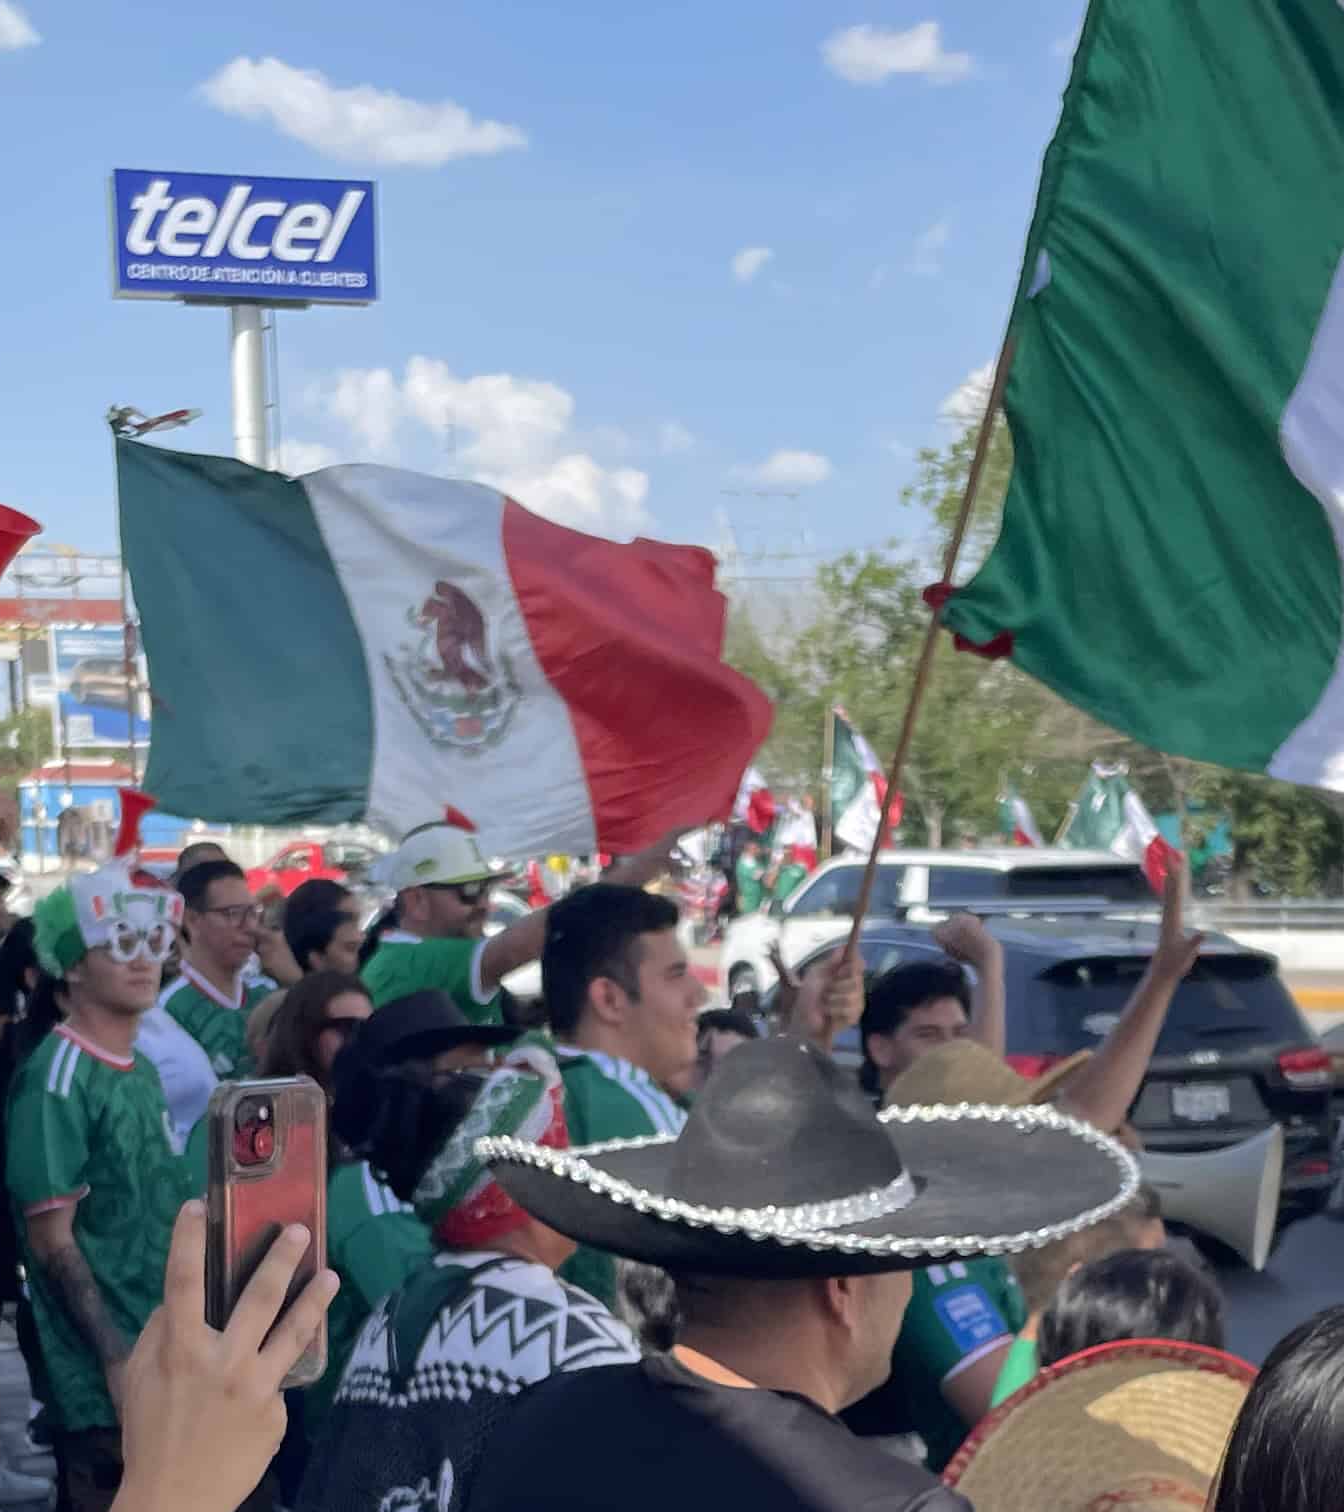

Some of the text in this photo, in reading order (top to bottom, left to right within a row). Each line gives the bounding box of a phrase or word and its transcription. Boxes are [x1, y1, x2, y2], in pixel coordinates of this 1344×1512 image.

[125, 180, 366, 263] telcel
[127, 263, 193, 281] CENTRO
[193, 266, 211, 282] DE
[299, 271, 368, 288] CLIENTES
